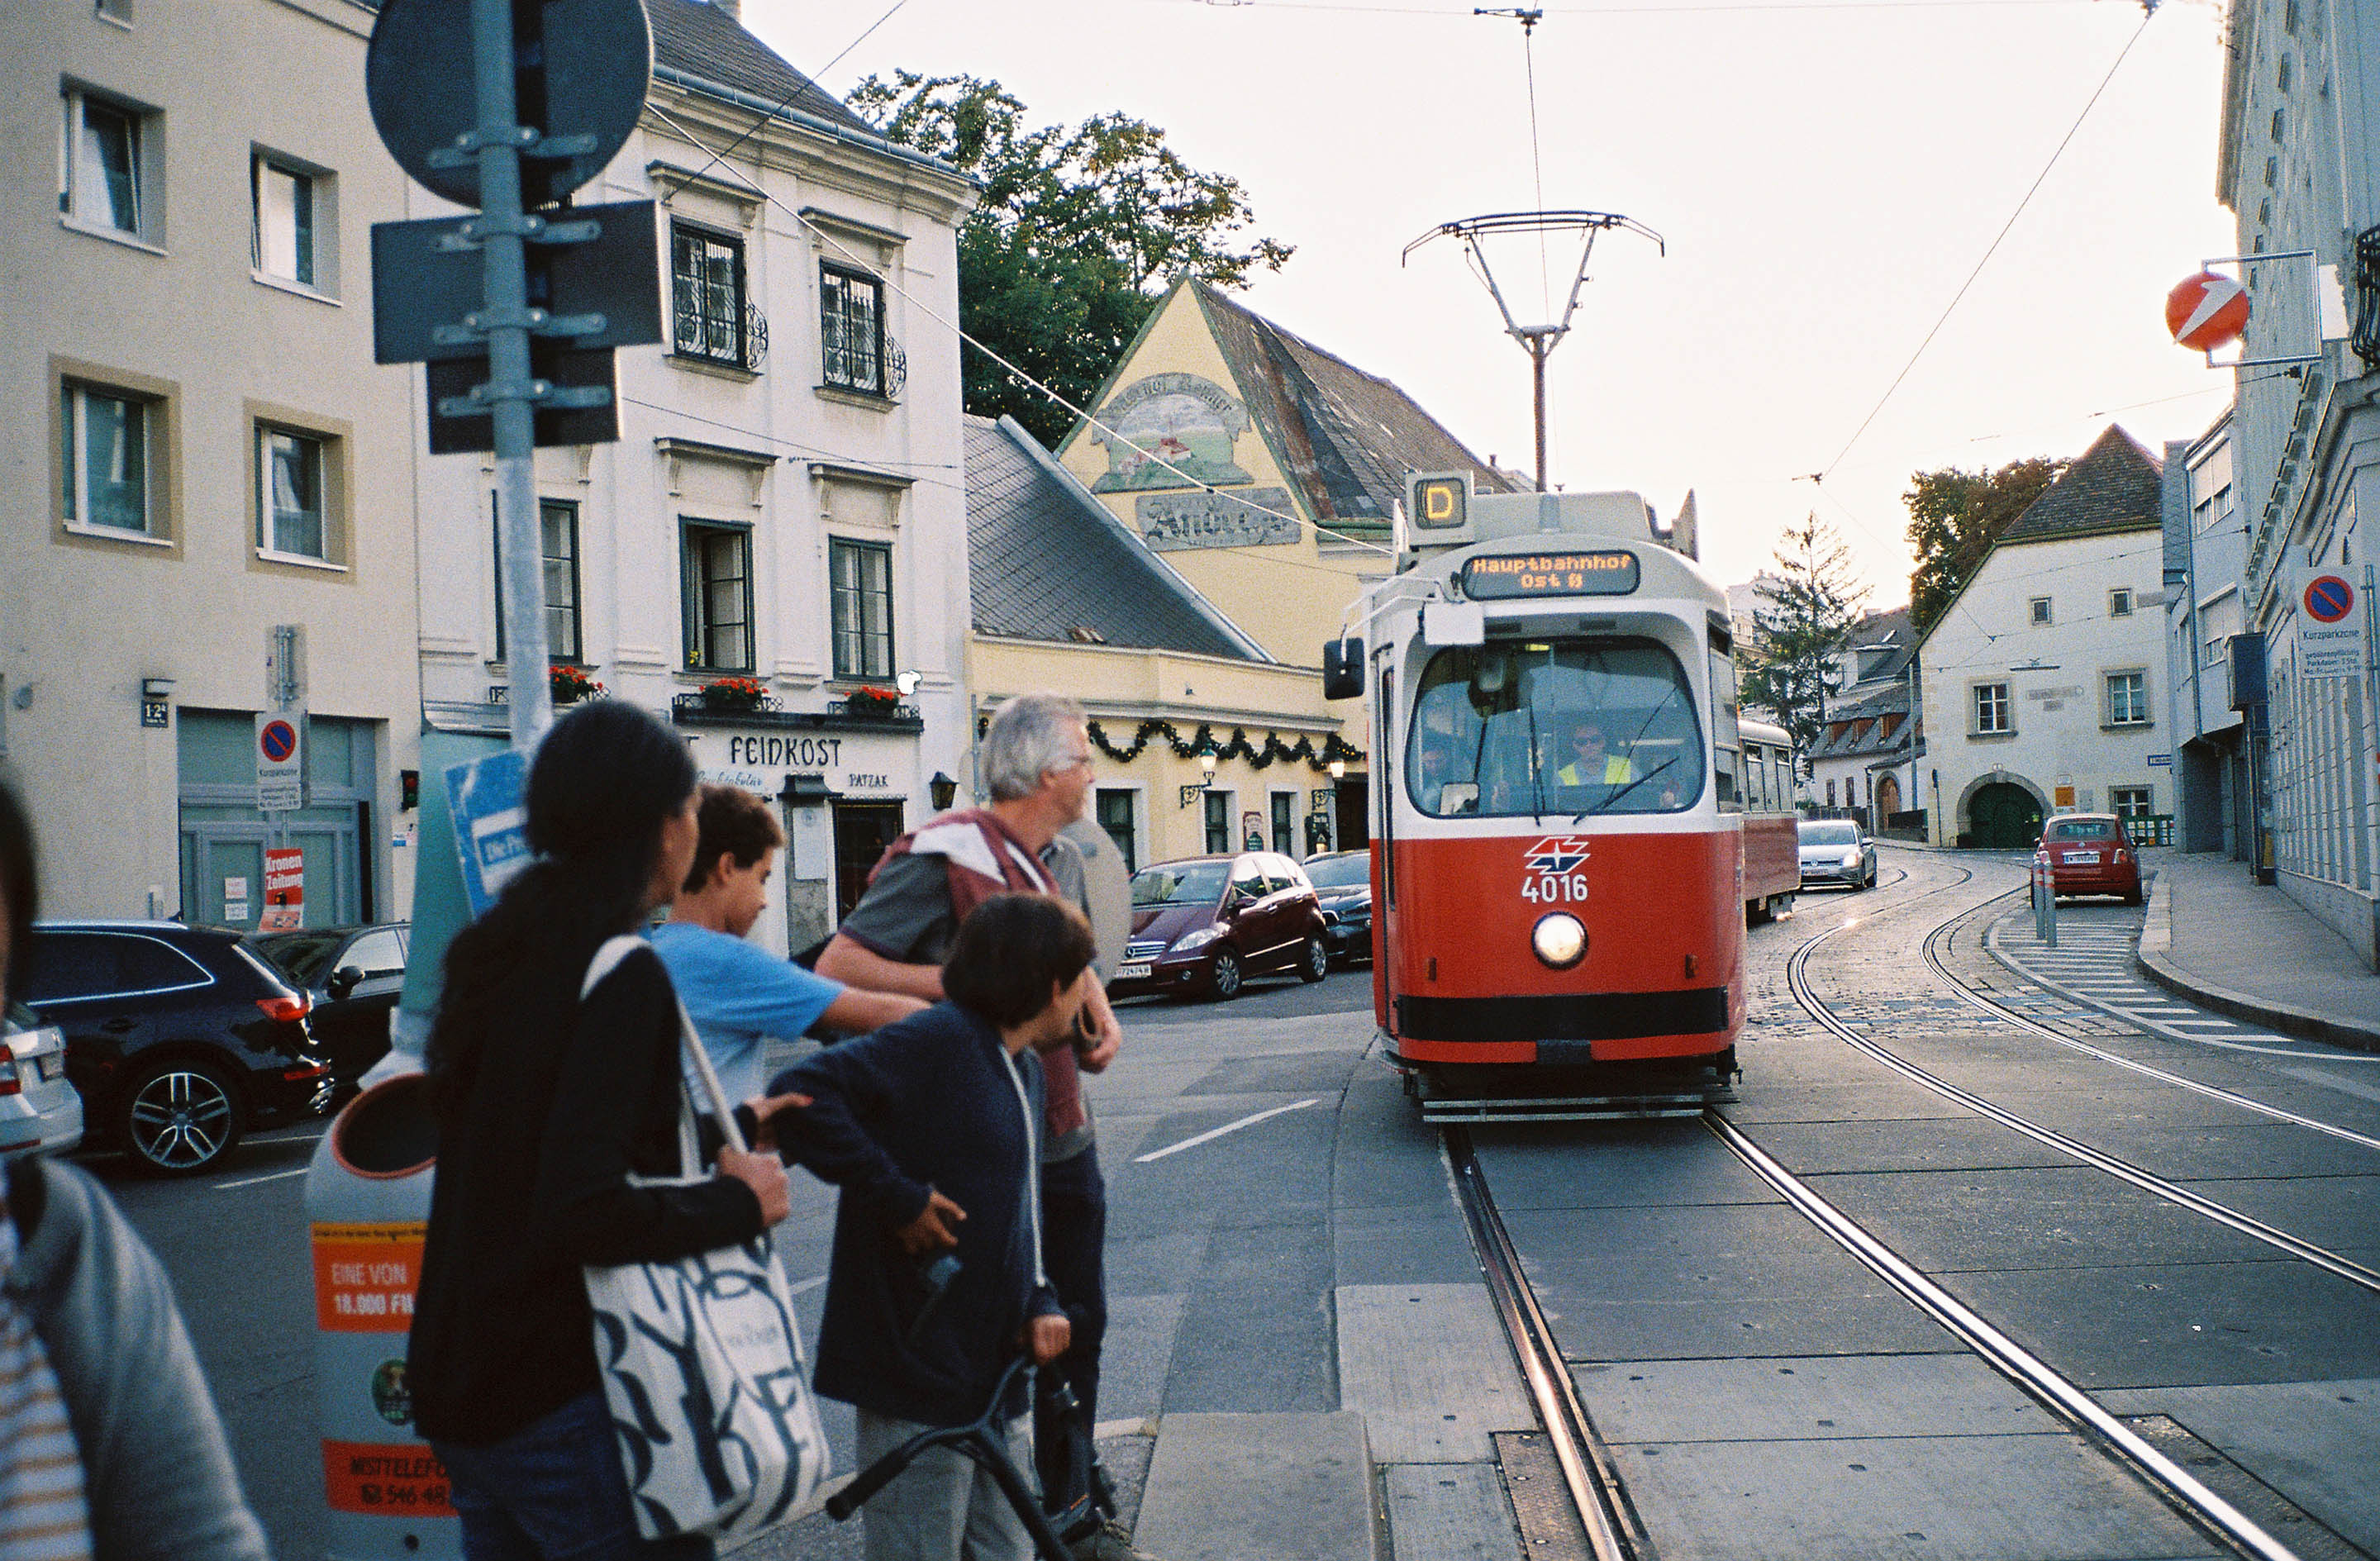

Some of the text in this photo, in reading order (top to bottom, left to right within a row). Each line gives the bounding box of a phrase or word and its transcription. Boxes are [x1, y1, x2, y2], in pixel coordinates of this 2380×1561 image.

[1427, 486, 1452, 519] D
[1473, 554, 1631, 573] Hauptbahnhof
[1521, 573, 1560, 588] Ost
[731, 735, 841, 767] FEINKOST
[849, 773, 889, 788] PATZAK
[264, 855, 302, 873] Kronen
[265, 873, 303, 891] Zeitung
[1521, 873, 1588, 904] 4016
[331, 1262, 407, 1286] EINE VON
